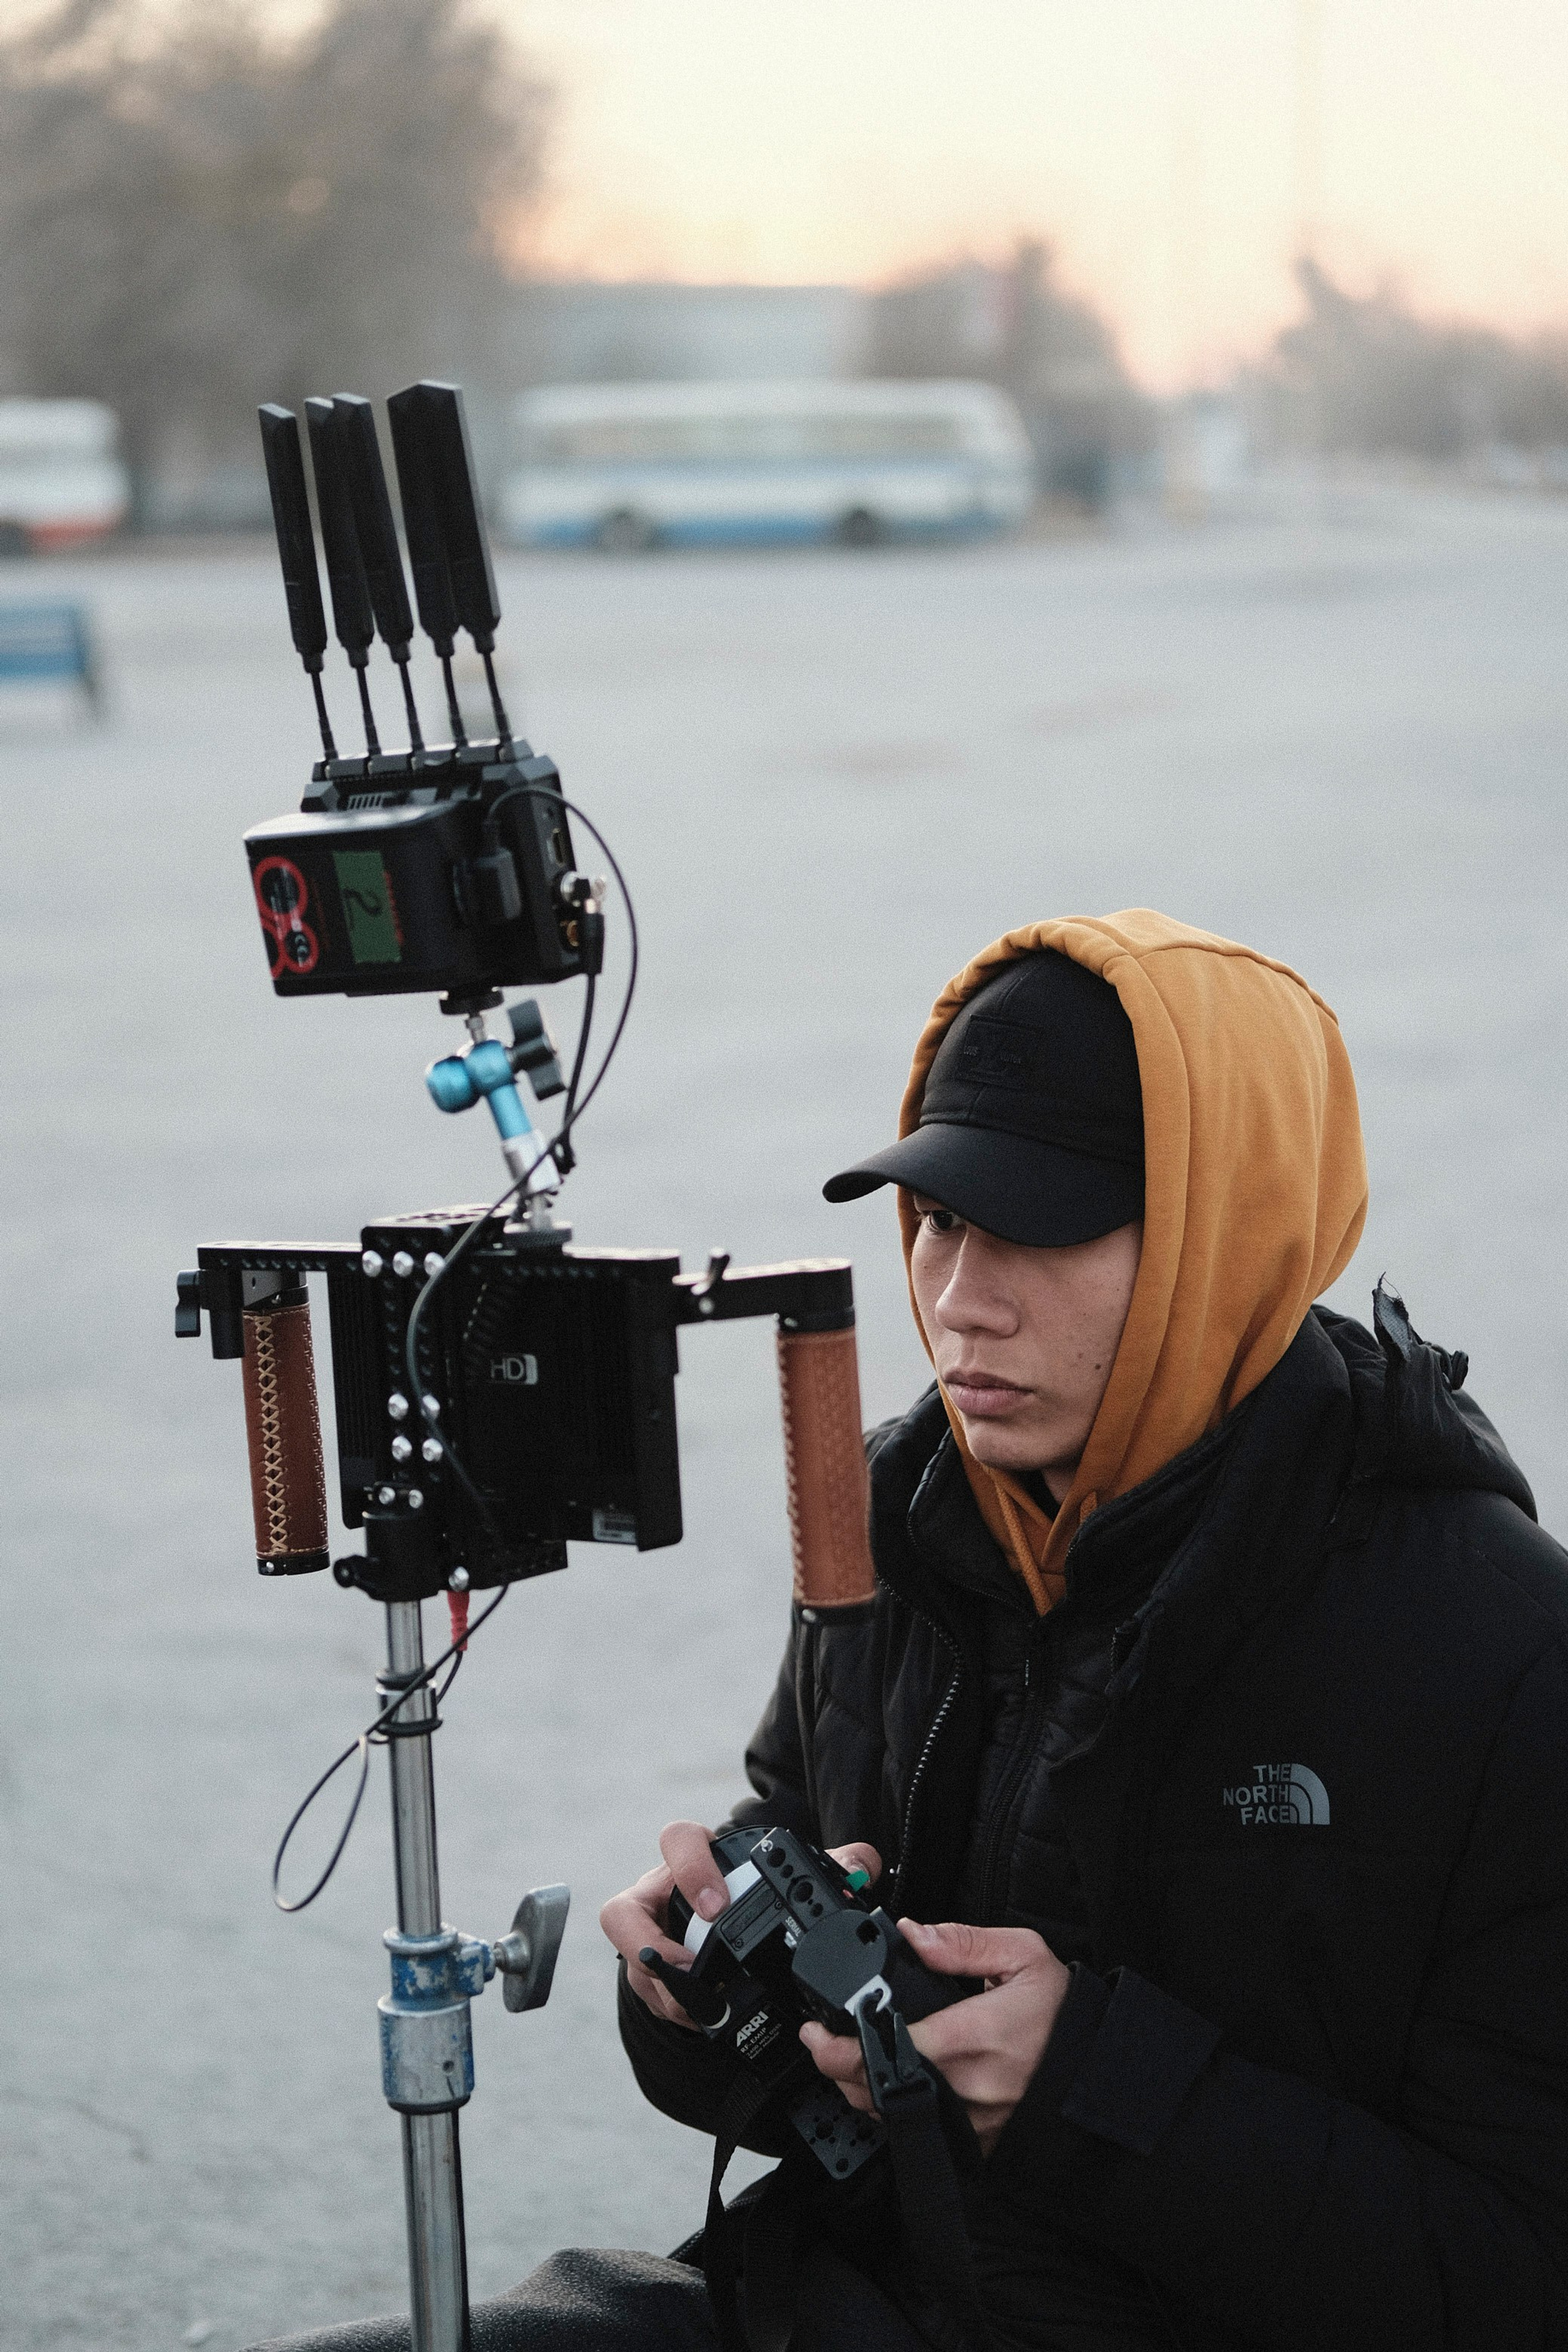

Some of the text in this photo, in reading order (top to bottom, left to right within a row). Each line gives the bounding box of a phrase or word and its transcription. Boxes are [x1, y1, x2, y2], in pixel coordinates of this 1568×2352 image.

[489, 1357, 525, 1380] HD
[1253, 1763, 1291, 1783] THE
[1223, 1784, 1290, 1806] NORTH
[1241, 1806, 1291, 1825] FACE
[785, 1915, 802, 1937] SERIAL
[736, 2010, 769, 2047] ARRI
[740, 2027, 766, 2053] RF-EMIP
